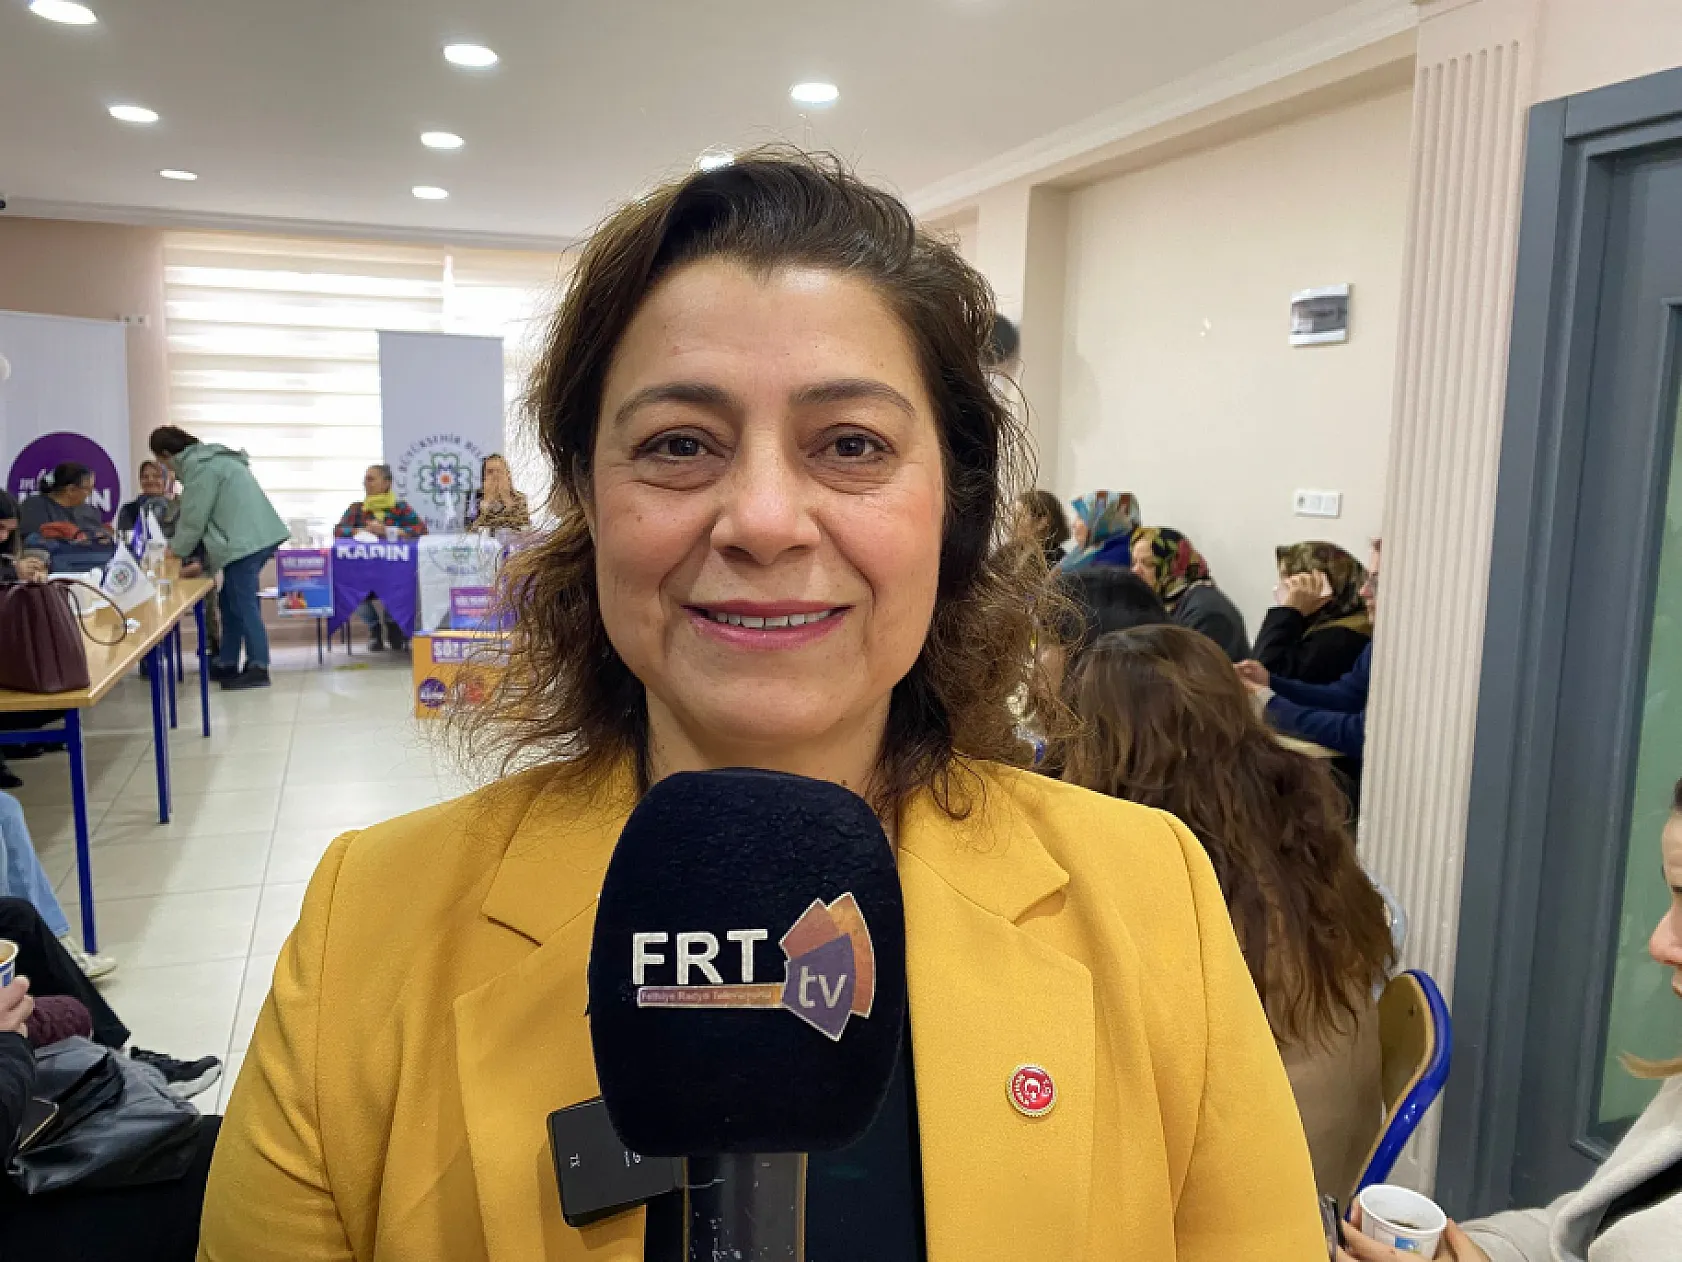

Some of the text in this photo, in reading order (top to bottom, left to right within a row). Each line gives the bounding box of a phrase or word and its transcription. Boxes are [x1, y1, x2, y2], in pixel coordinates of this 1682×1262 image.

[336, 543, 410, 561] KADIN
[632, 929, 768, 985] FRT
[798, 965, 847, 1008] tv
